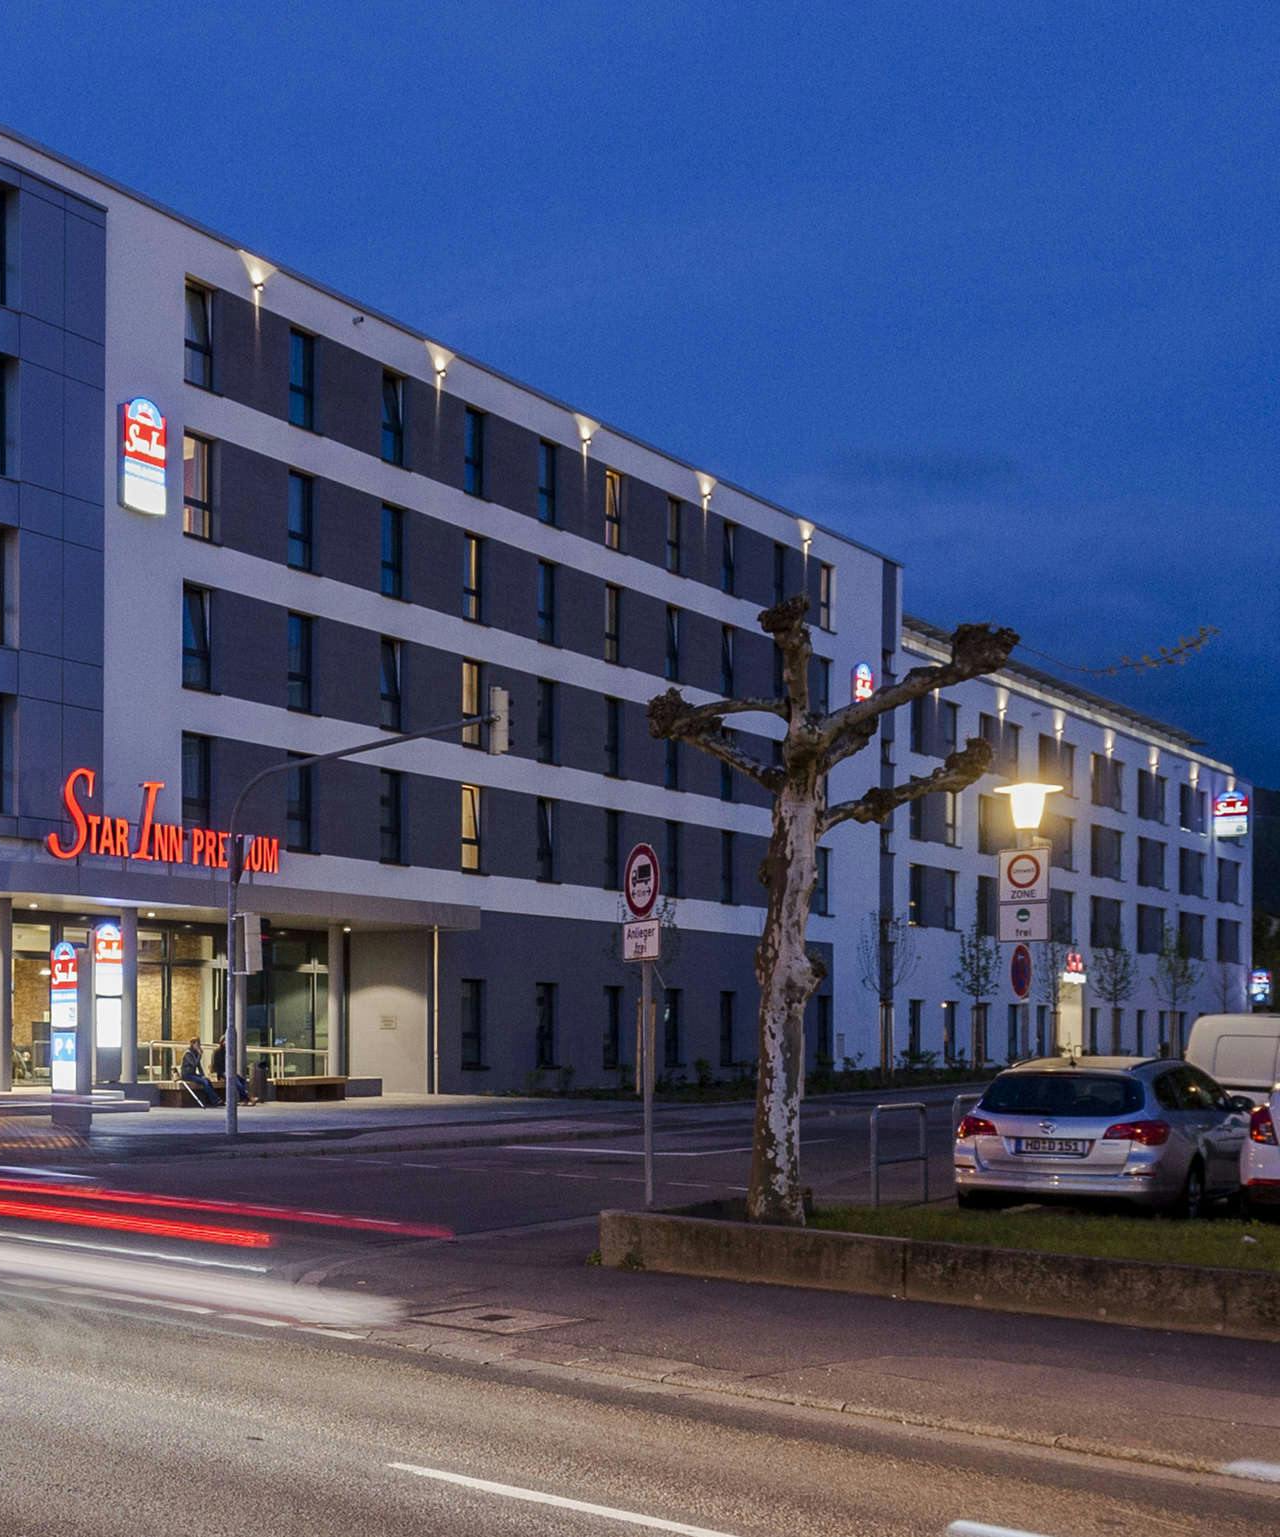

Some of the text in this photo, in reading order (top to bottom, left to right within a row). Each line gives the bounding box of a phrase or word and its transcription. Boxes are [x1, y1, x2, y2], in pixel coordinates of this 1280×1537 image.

[192, 827, 280, 875] PREUM
[1011, 889, 1036, 899] ZONE
[626, 927, 656, 941] Anlieger
[1015, 928, 1032, 937] frei
